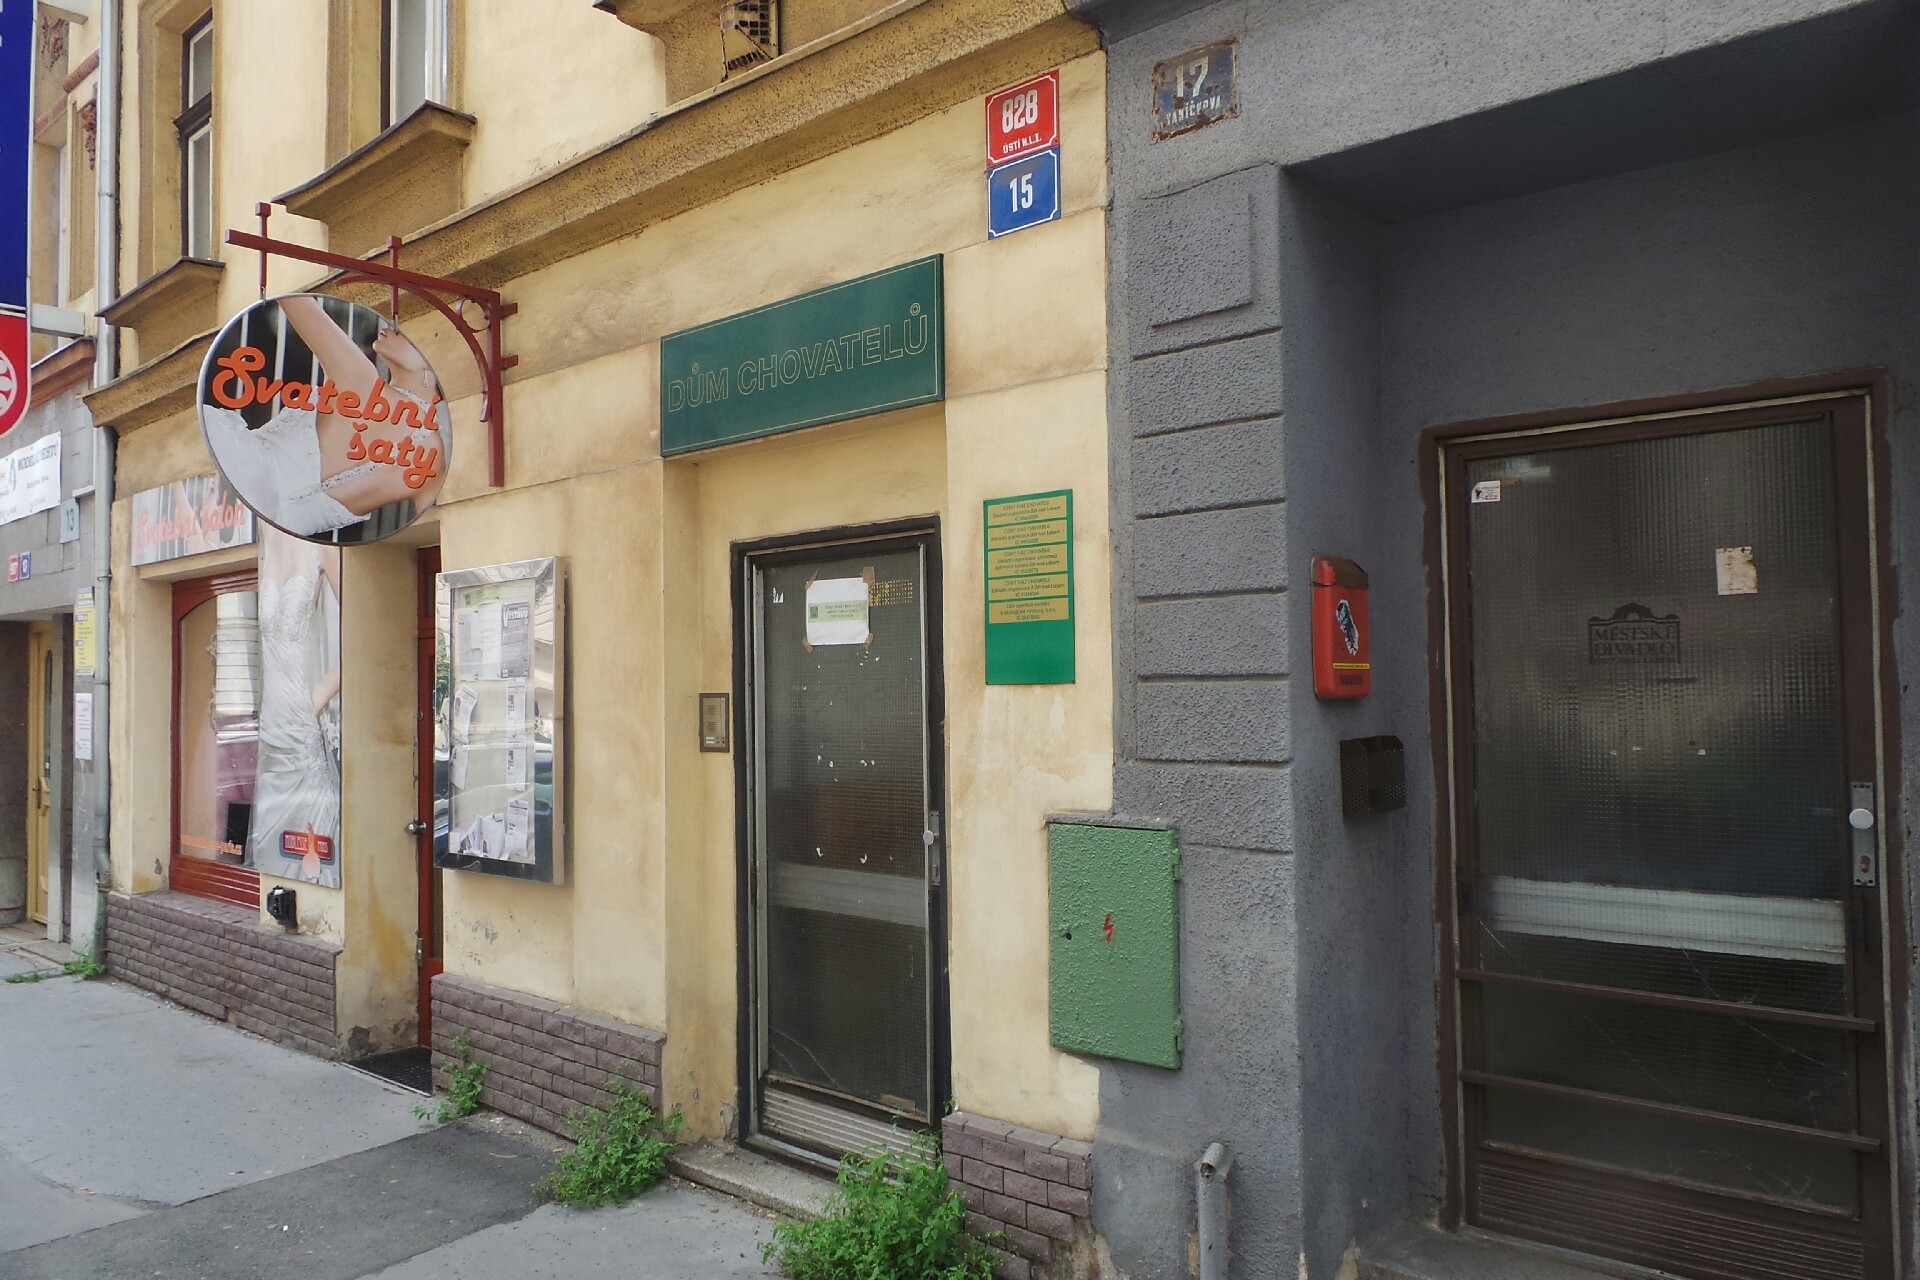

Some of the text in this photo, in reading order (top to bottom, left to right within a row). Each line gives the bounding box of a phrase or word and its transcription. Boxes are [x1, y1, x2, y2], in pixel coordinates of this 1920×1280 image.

[1176, 56, 1209, 98] 17
[1002, 89, 1038, 134] 828
[1003, 138, 1020, 153] ÚSTÍ
[1009, 172, 1033, 212] 15
[668, 302, 928, 412] DŮM CHOVATELŮ
[212, 346, 441, 431] Svatební
[346, 421, 438, 489] šaty
[66, 508, 75, 532] 13
[134, 491, 246, 556] Svatební salon
[1593, 642, 1674, 656] DIVADLO
